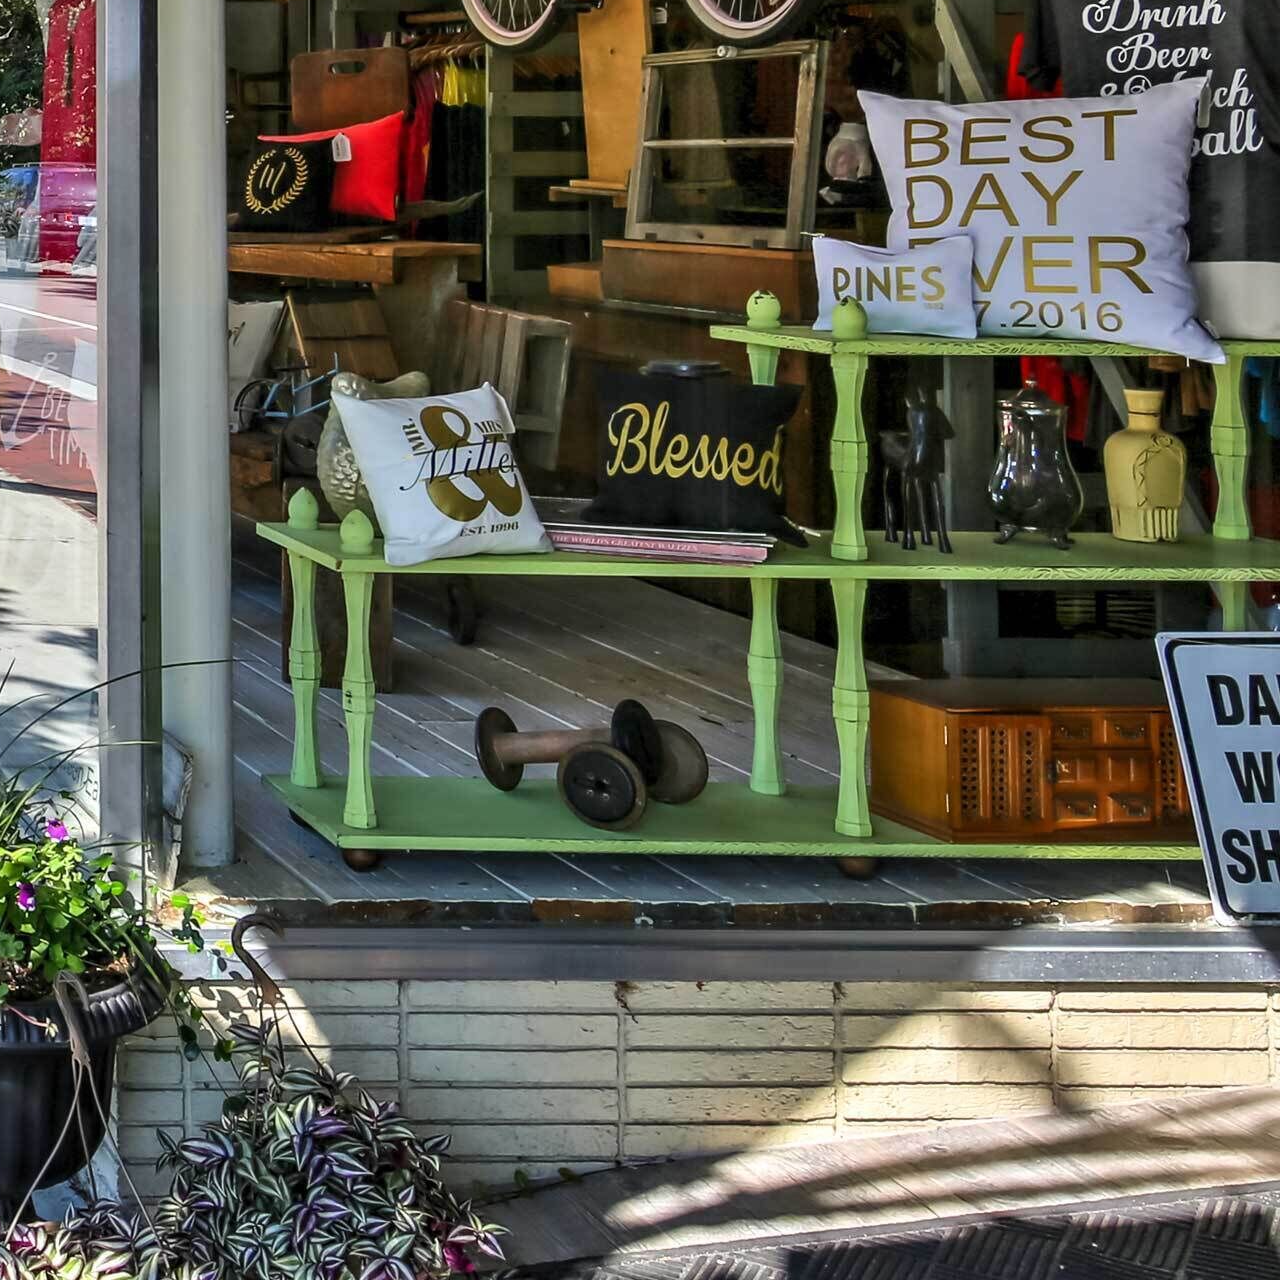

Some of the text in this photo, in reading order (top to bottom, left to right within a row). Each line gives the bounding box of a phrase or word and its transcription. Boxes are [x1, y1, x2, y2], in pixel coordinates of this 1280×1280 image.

[1106, 32, 1213, 74] Beer
[904, 109, 1138, 169] BEST
[905, 170, 1084, 229] DAY
[833, 266, 946, 302] PINES
[908, 236, 1154, 294] VER
[607, 401, 784, 496] Blessed
